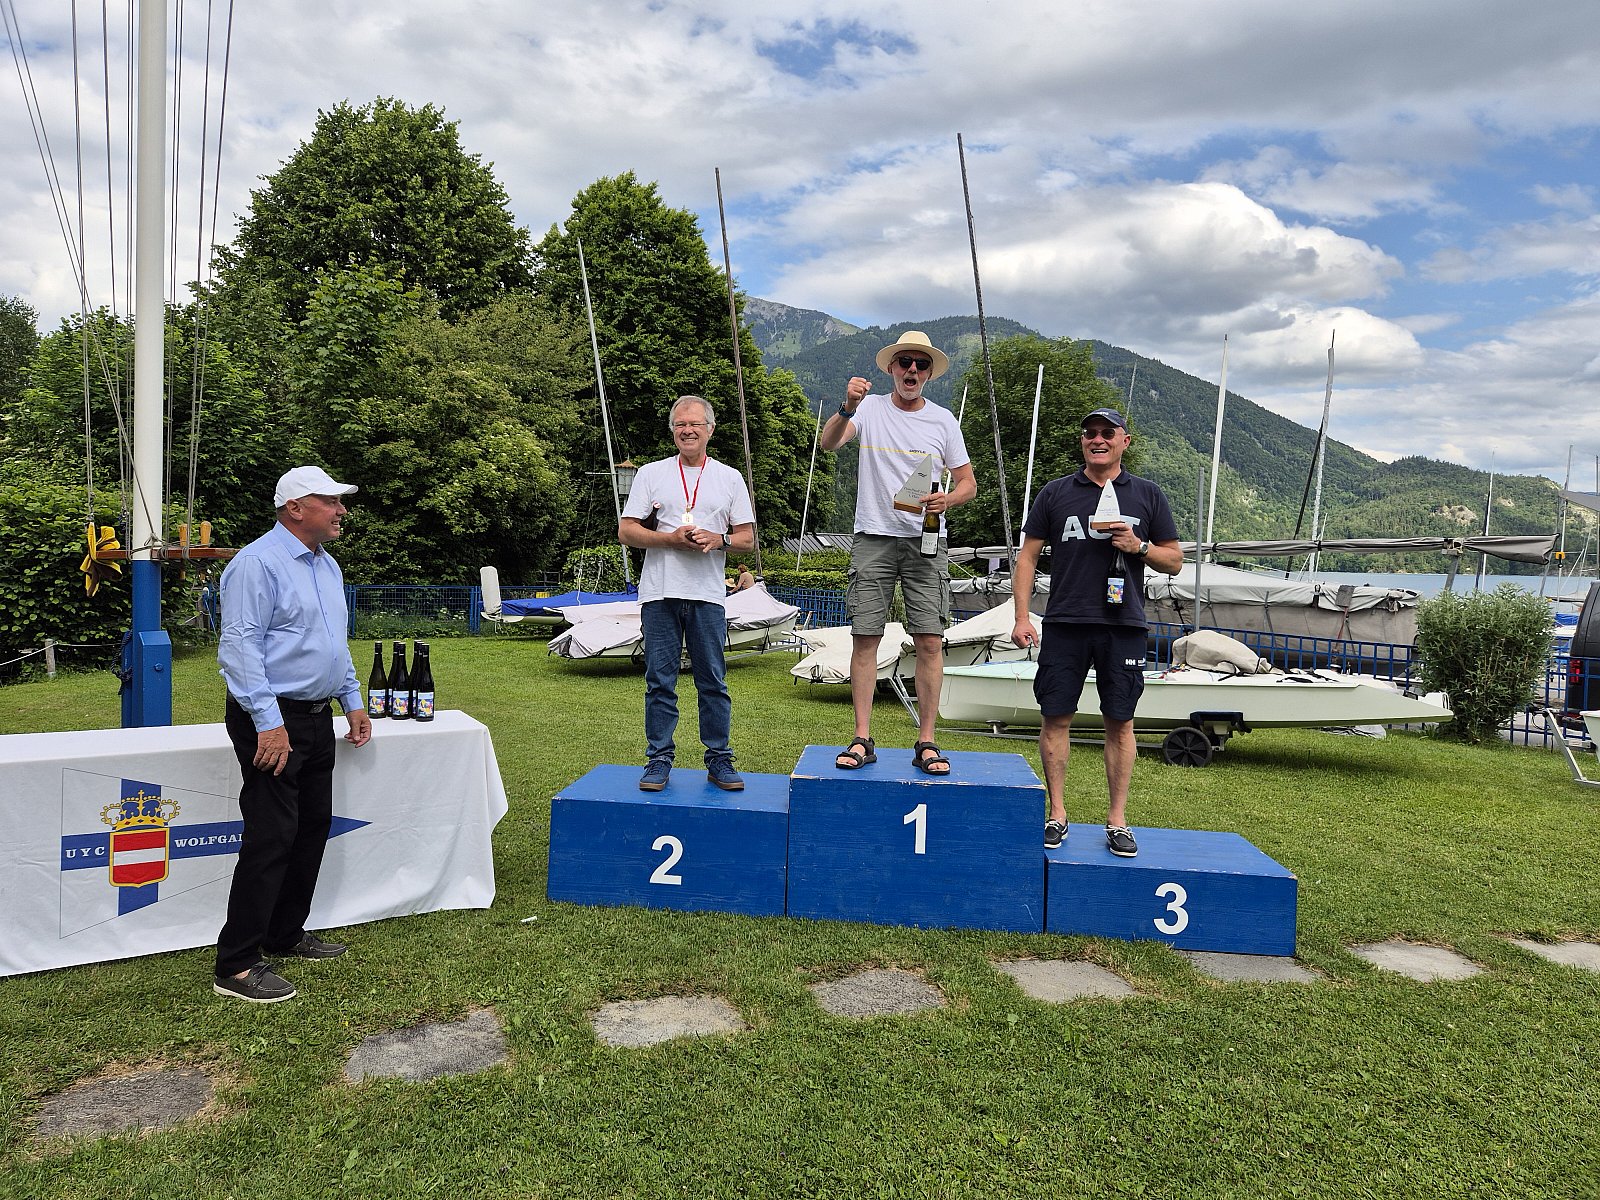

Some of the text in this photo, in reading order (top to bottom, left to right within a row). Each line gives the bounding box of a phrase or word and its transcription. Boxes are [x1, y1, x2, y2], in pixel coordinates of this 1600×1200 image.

[903, 803, 927, 855] 1
[649, 835, 684, 886] 2
[1153, 882, 1189, 935] 3
